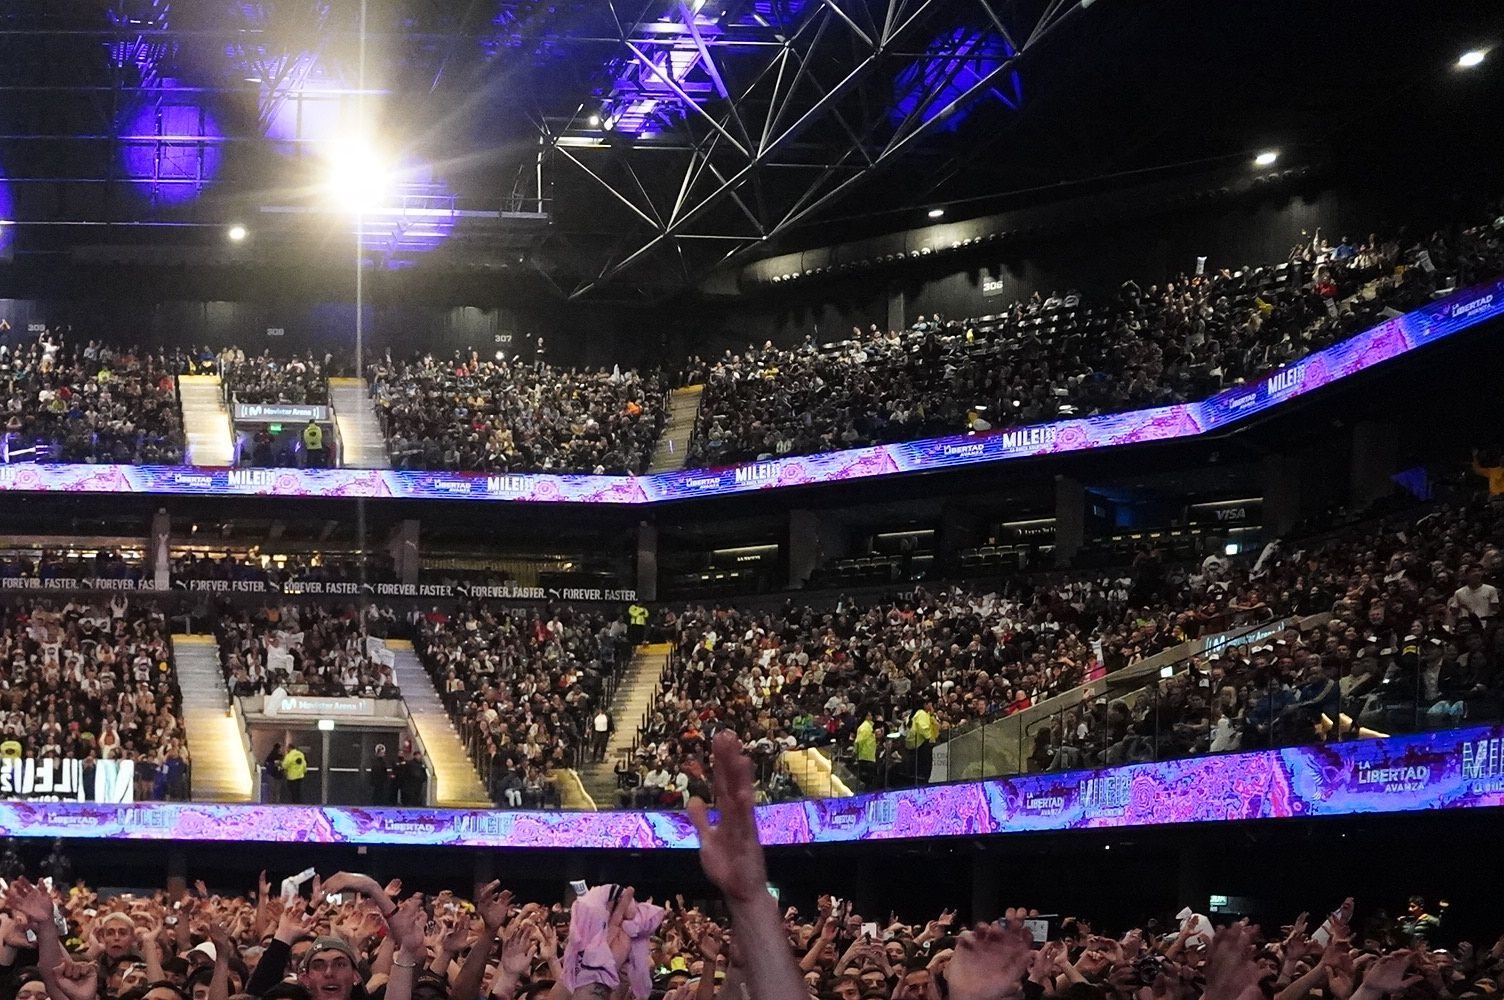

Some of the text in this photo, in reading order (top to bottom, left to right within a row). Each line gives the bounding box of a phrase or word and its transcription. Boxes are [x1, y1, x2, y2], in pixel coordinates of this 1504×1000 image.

[983, 281, 1003, 291] 306
[1452, 294, 1493, 317] LIBERTAD
[1268, 367, 1297, 394] MILEI
[264, 407, 311, 416] Movistar Arena
[1002, 428, 1044, 448] MILEI
[944, 444, 984, 455] LIBERTAD
[228, 471, 265, 485] MILEI
[735, 464, 771, 482] MILEI
[488, 477, 526, 491] MILEI
[686, 477, 720, 488] LIBERTAD
[1217, 508, 1246, 521] VISA
[3, 577, 80, 588] FOREVER. FASTER.
[96, 579, 137, 590] FOREVER.
[190, 580, 267, 592] FOREVER. FASTER.
[326, 582, 360, 594] FASTER.
[378, 583, 454, 596] FOREVER. FASTER.
[471, 586, 547, 598] FOREVER. FASTER.
[563, 588, 638, 601] FOREVER. FASTER.
[1359, 760, 1371, 770] LA
[1359, 766, 1430, 784] LIBERTAD
[1386, 783, 1425, 793] AVANZA
[1026, 797, 1063, 809] LIBERTAD
